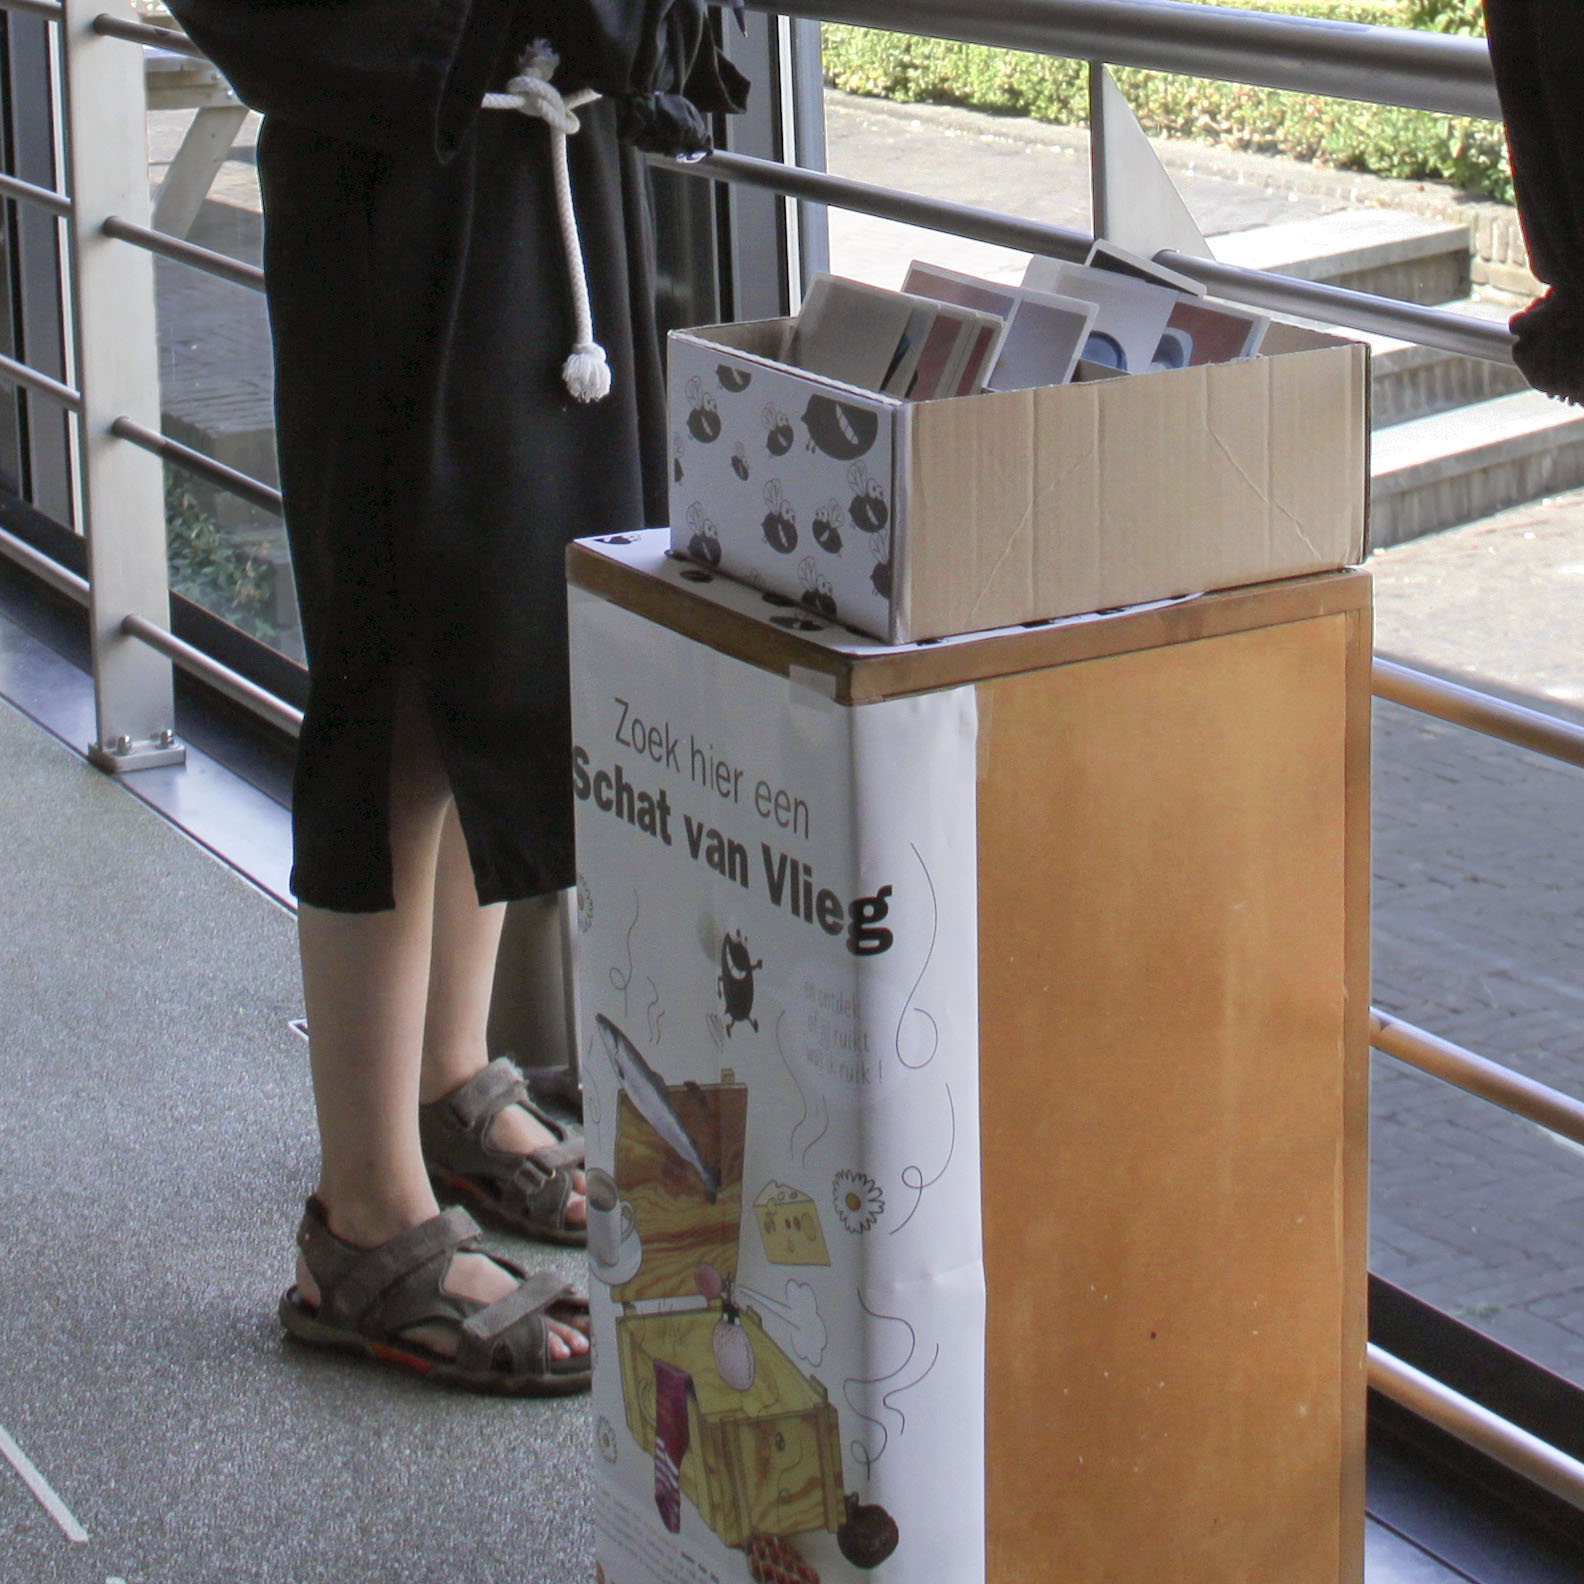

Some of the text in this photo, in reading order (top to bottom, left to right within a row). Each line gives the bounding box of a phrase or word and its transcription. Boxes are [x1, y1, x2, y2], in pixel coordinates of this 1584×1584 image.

[573, 744, 894, 956] Schat van Vlieg
[614, 696, 809, 840] Zoek hier een
